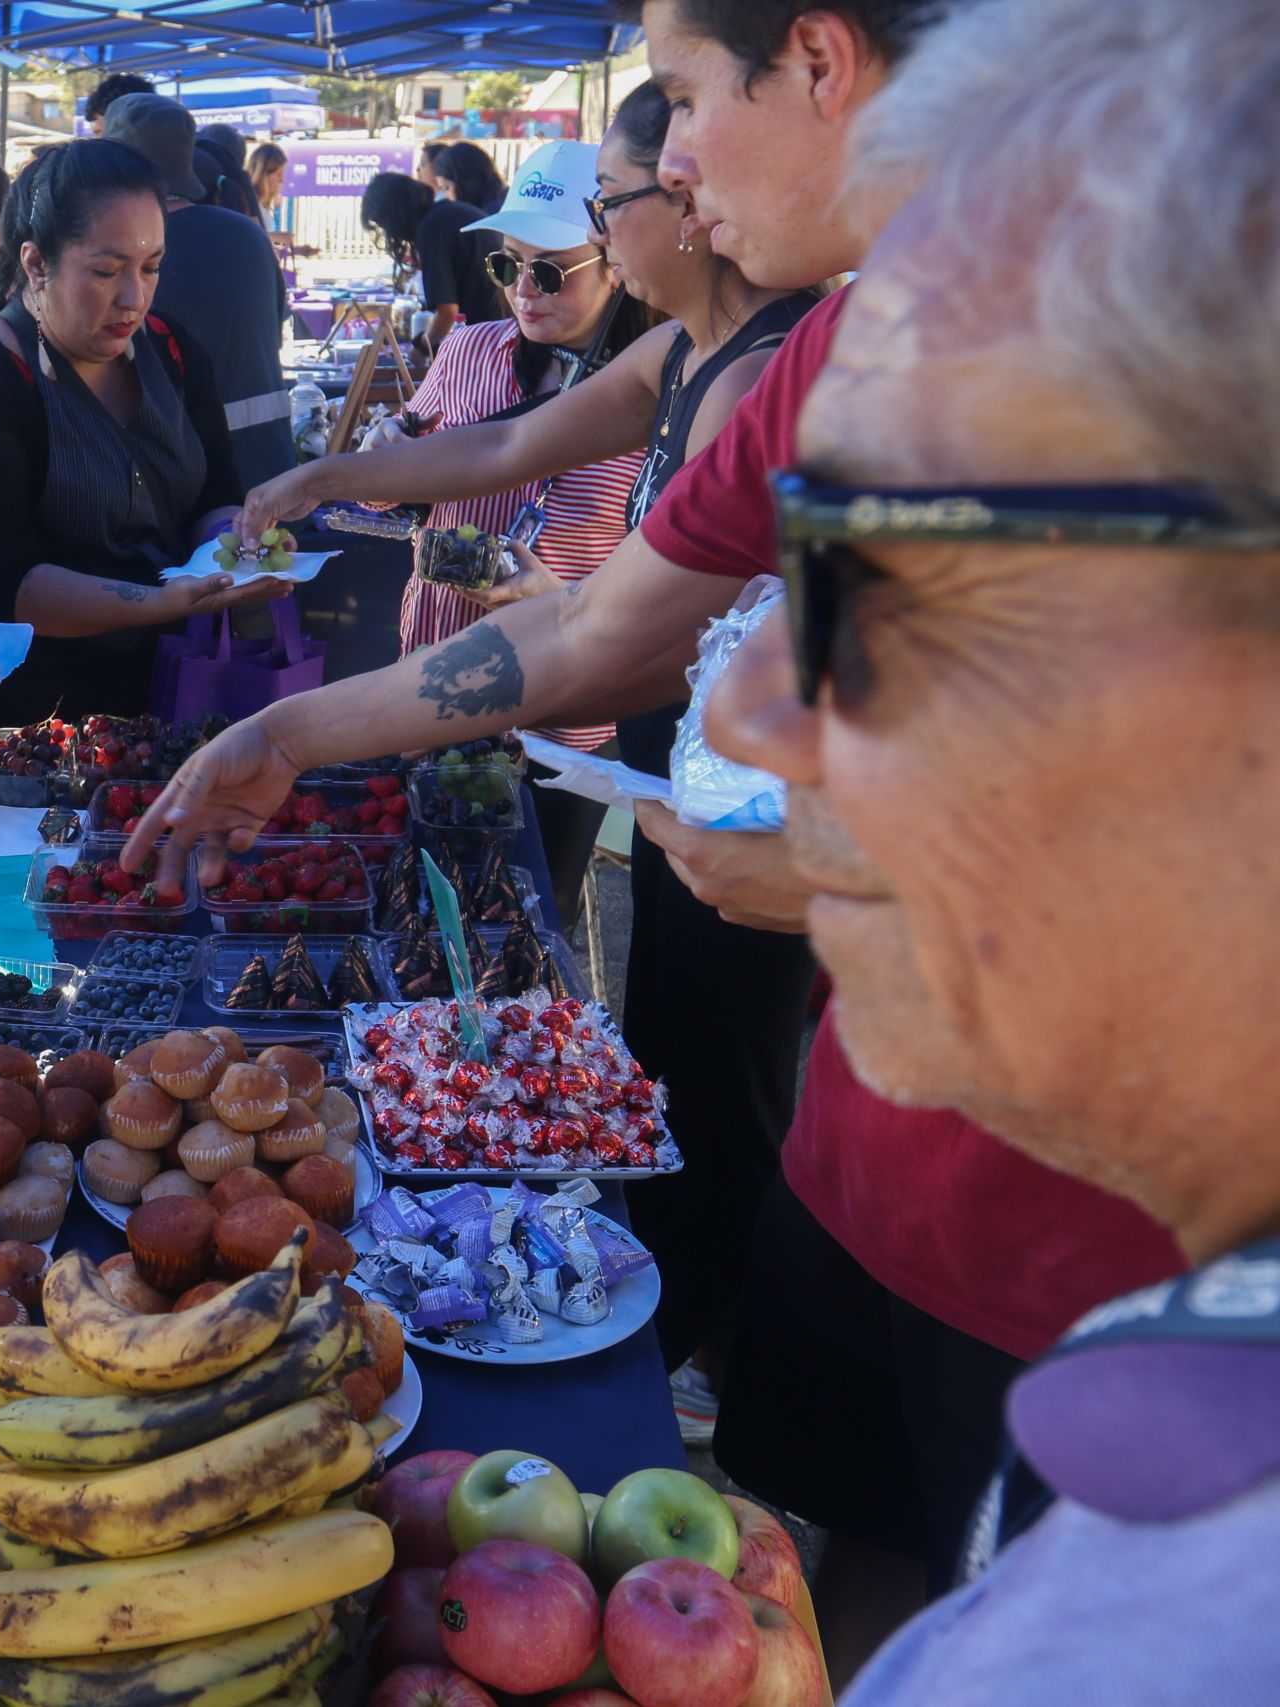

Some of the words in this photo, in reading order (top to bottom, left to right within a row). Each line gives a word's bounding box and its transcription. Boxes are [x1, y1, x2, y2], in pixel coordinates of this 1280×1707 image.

[316, 154, 380, 166] ESPACIO
[524, 187, 554, 201] Navia
[533, 181, 564, 197] Cerro
